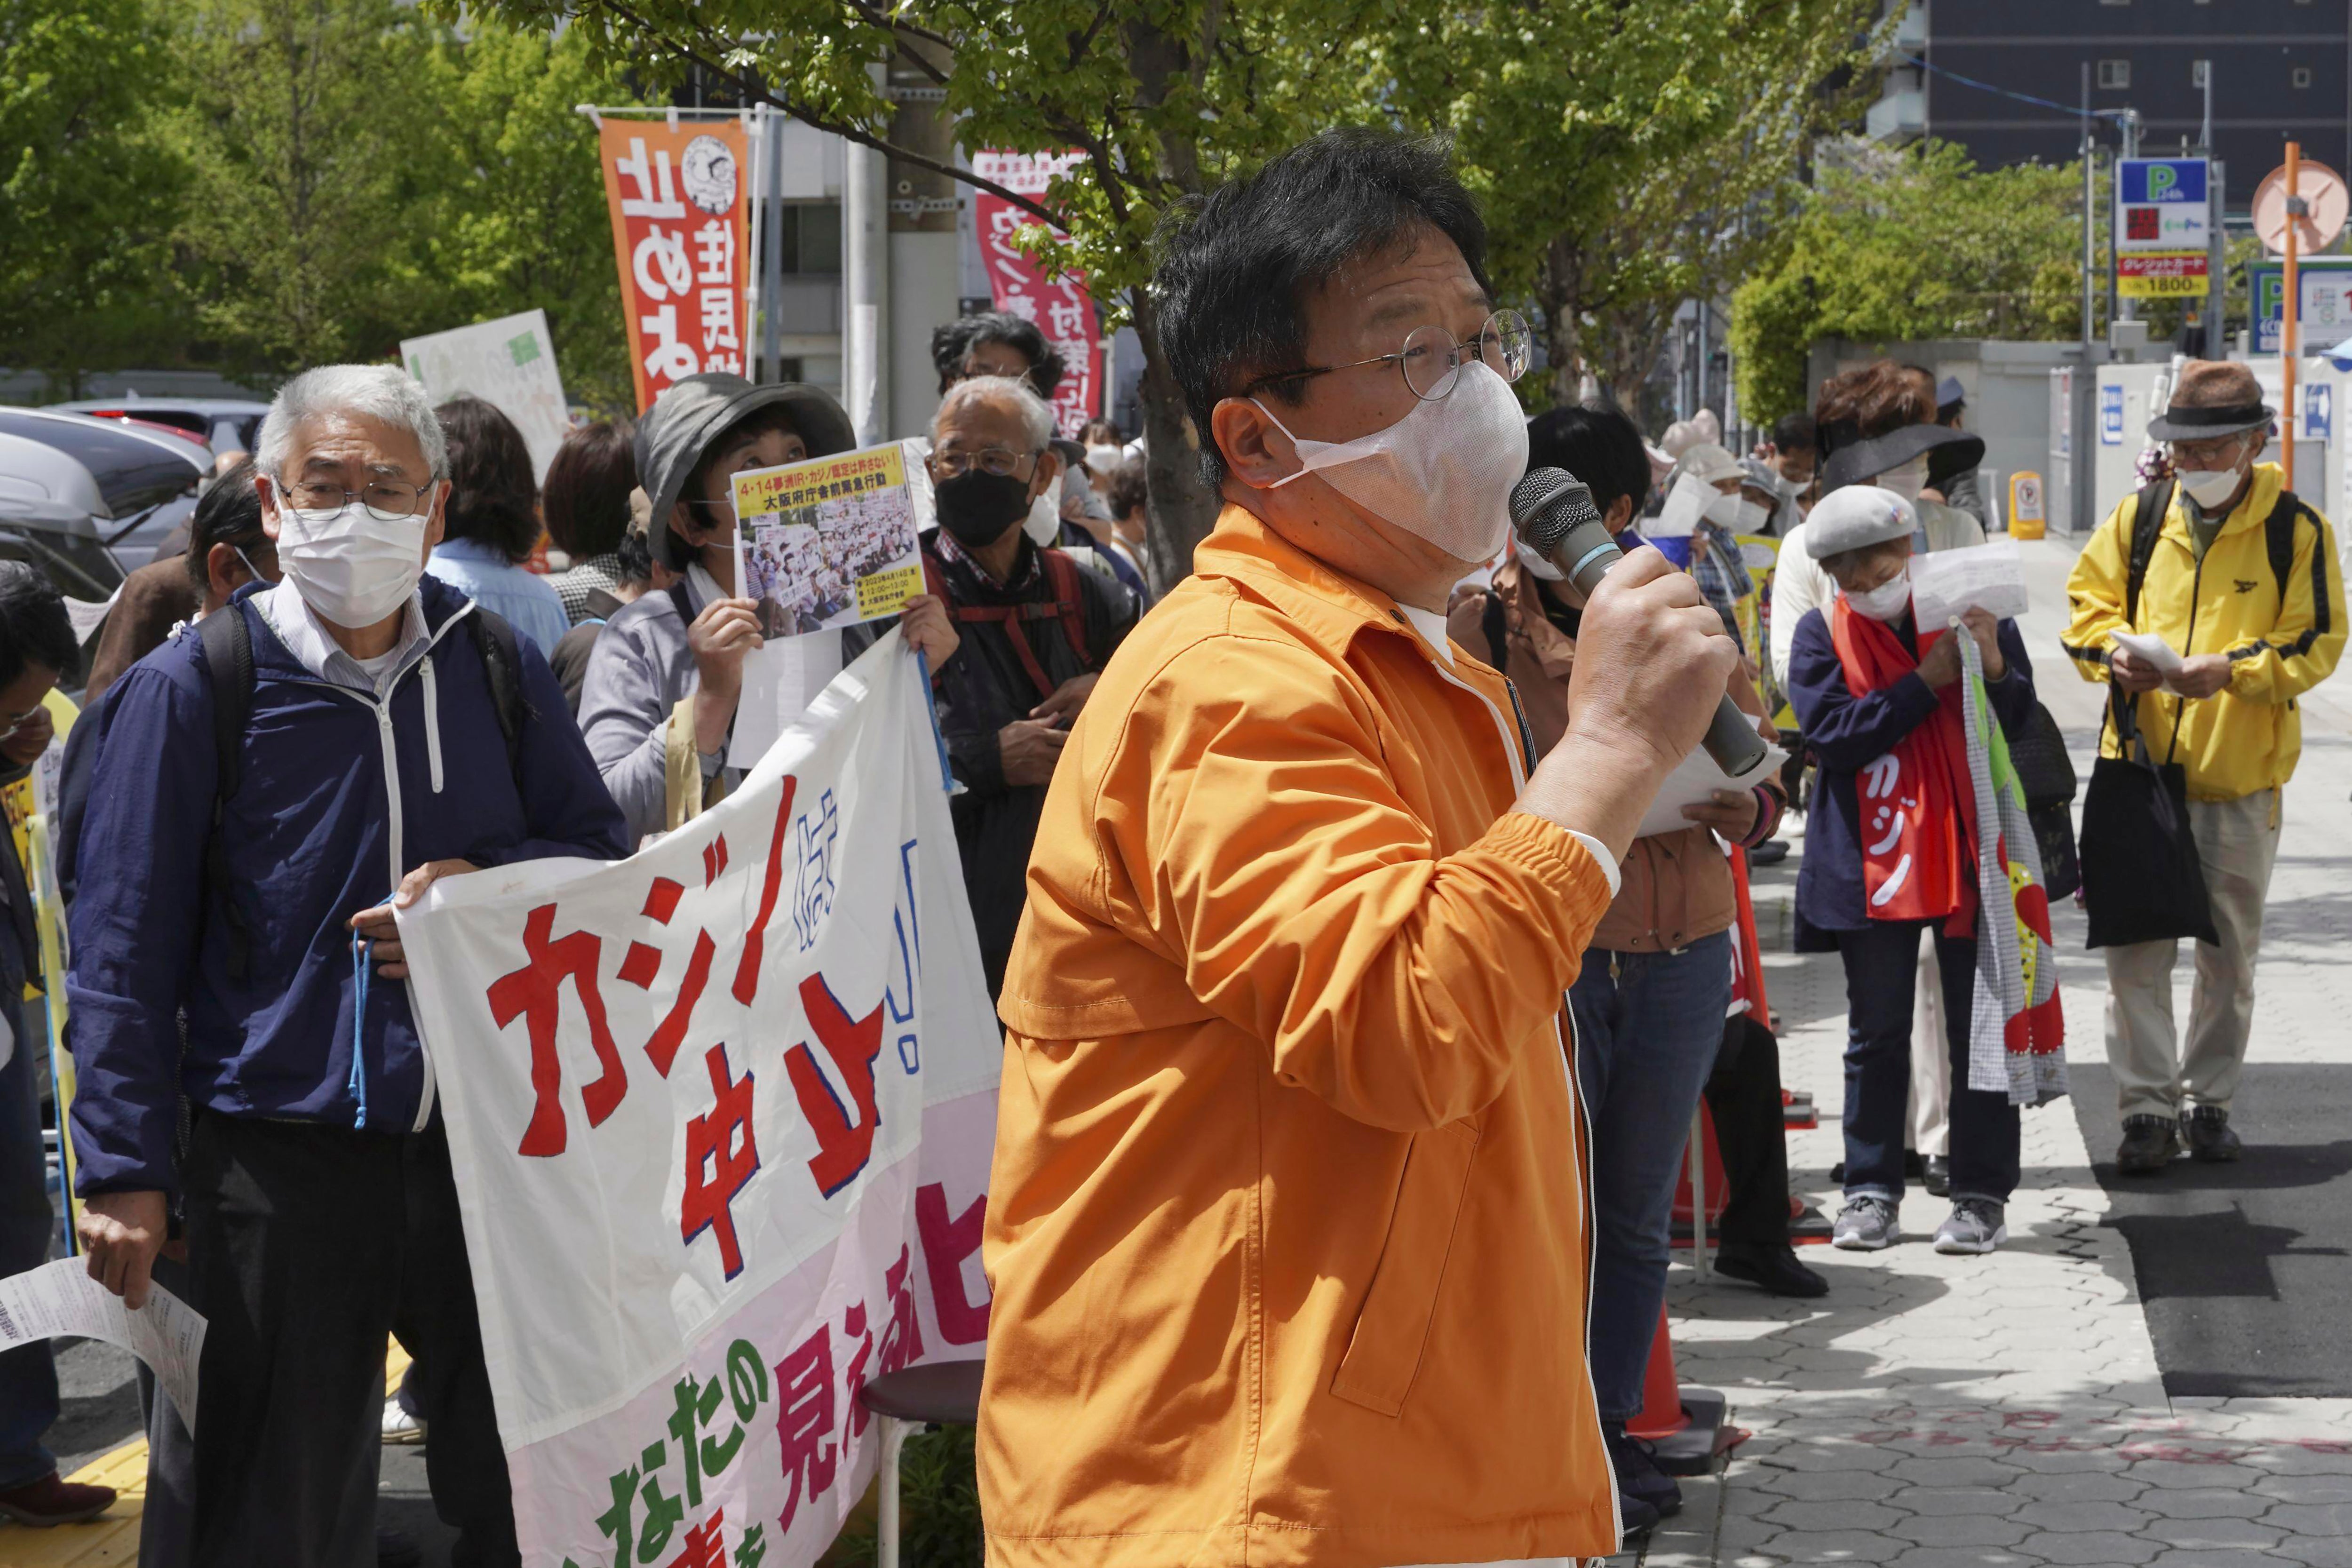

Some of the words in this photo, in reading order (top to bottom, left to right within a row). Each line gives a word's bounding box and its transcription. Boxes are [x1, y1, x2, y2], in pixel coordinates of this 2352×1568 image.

[2147, 165, 2177, 201] P
[2148, 277, 2192, 291] 1800
[1864, 754, 1915, 906] カジノ
[561, 1338, 768, 1568] なたの
